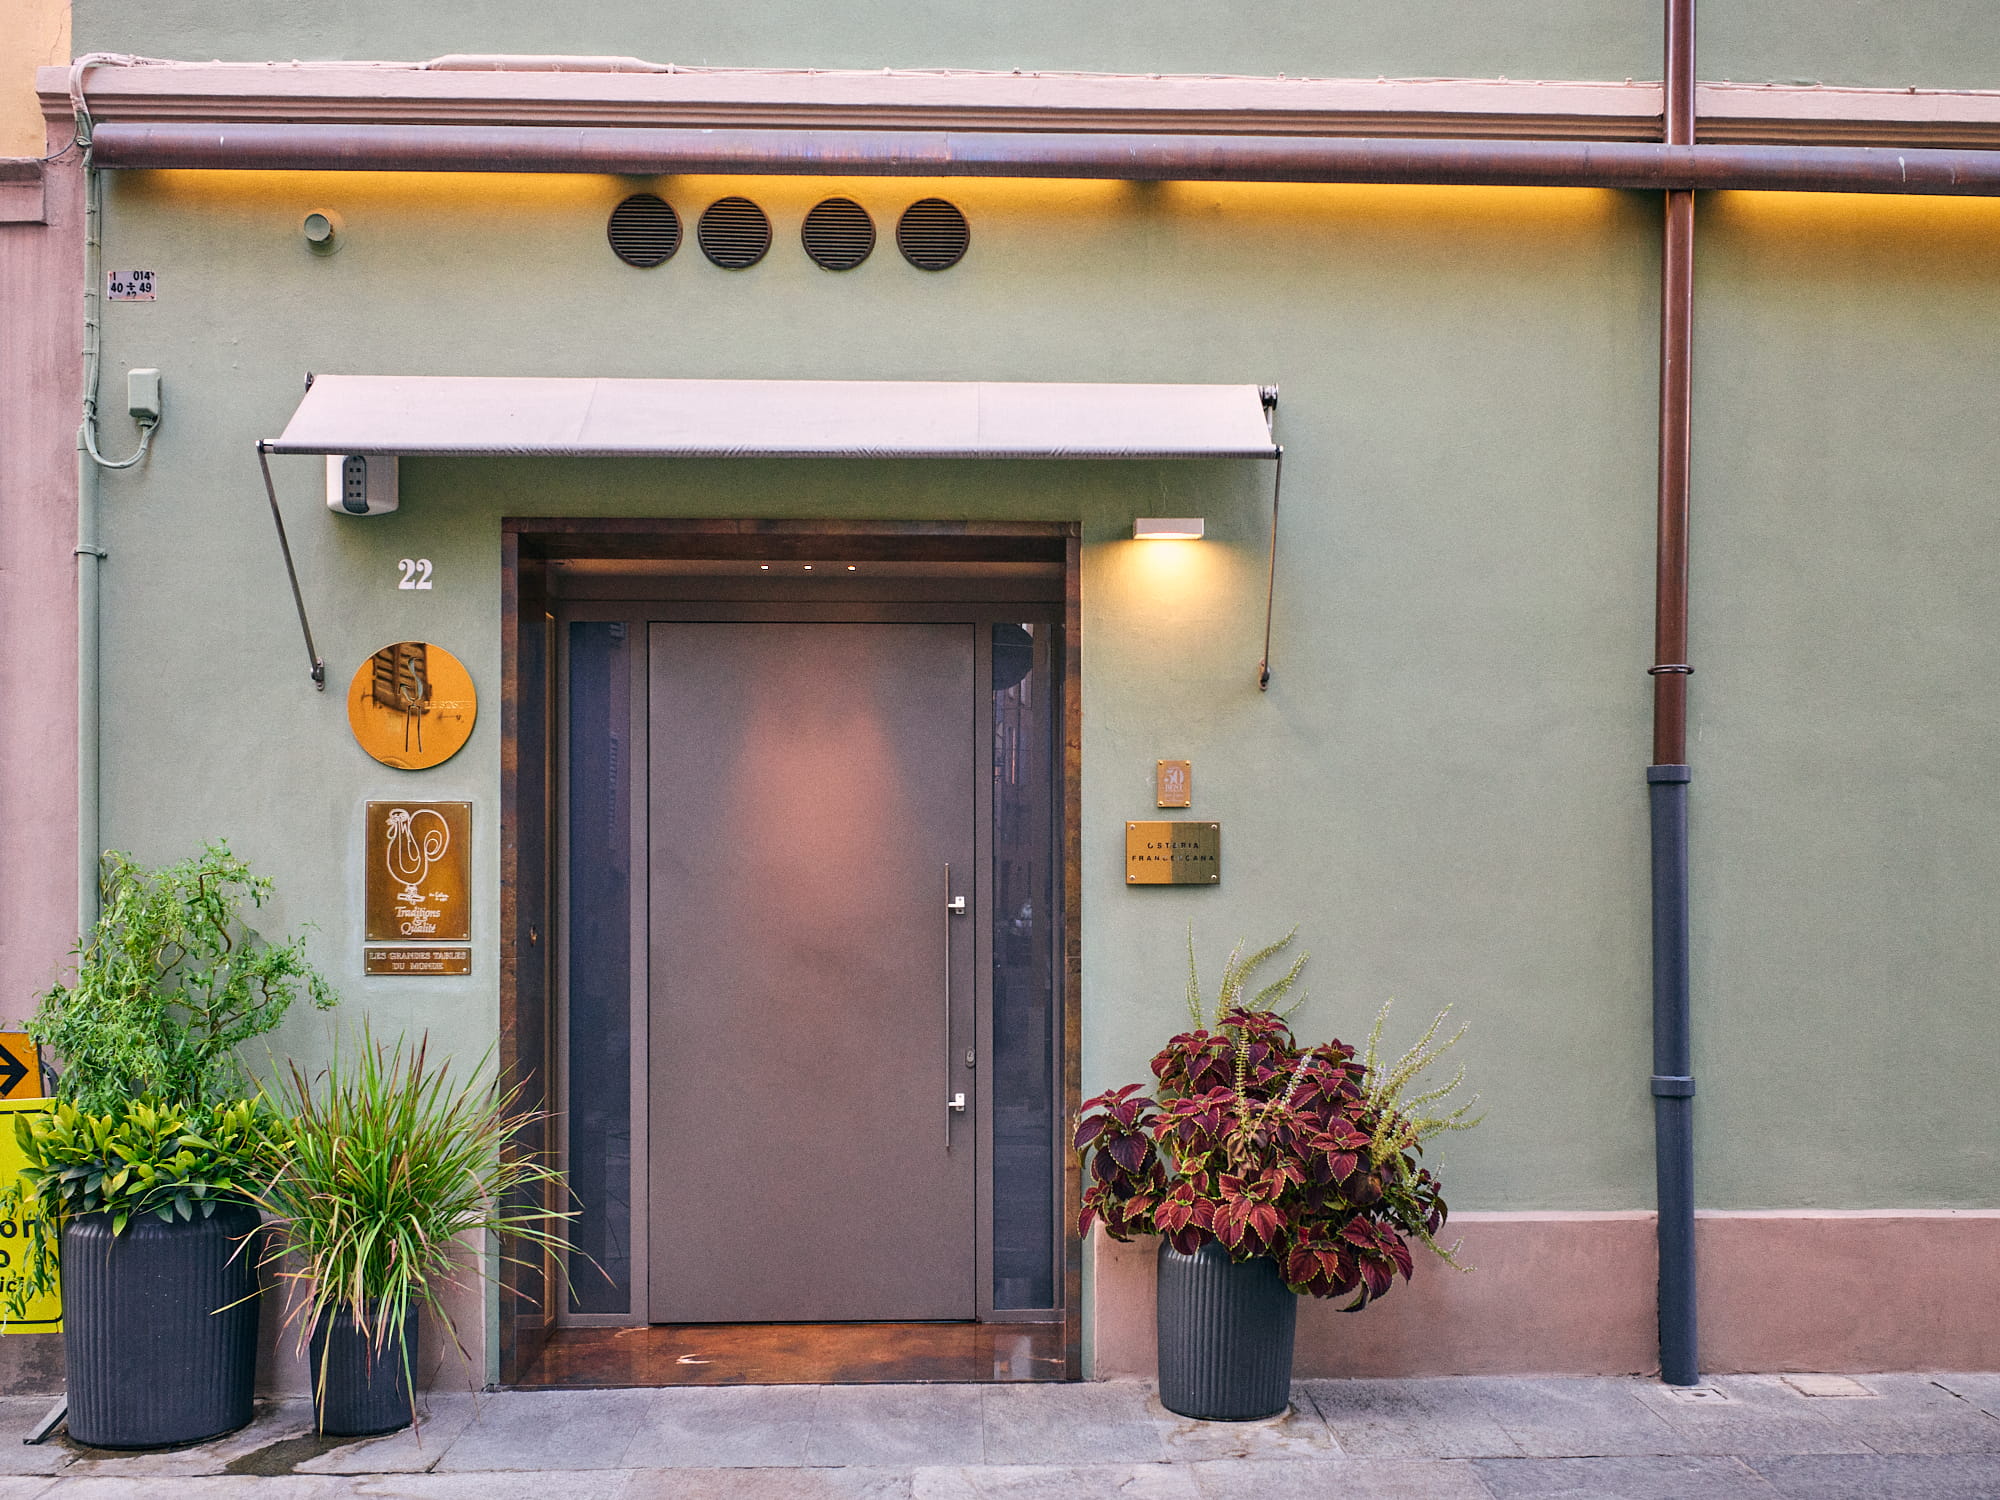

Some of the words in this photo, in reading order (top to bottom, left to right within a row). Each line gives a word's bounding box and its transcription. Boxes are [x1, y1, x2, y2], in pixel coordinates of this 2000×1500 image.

[133, 271, 150, 281] 014
[111, 283, 124, 292] 40
[139, 283, 152, 292] 49
[398, 558, 433, 590] 22
[1164, 767, 1185, 785] 50
[369, 951, 387, 960] LES
[389, 951, 431, 960] GRANDES
[432, 951, 467, 960] TABLES
[392, 962, 406, 970] DU
[409, 962, 445, 970] MONDE
